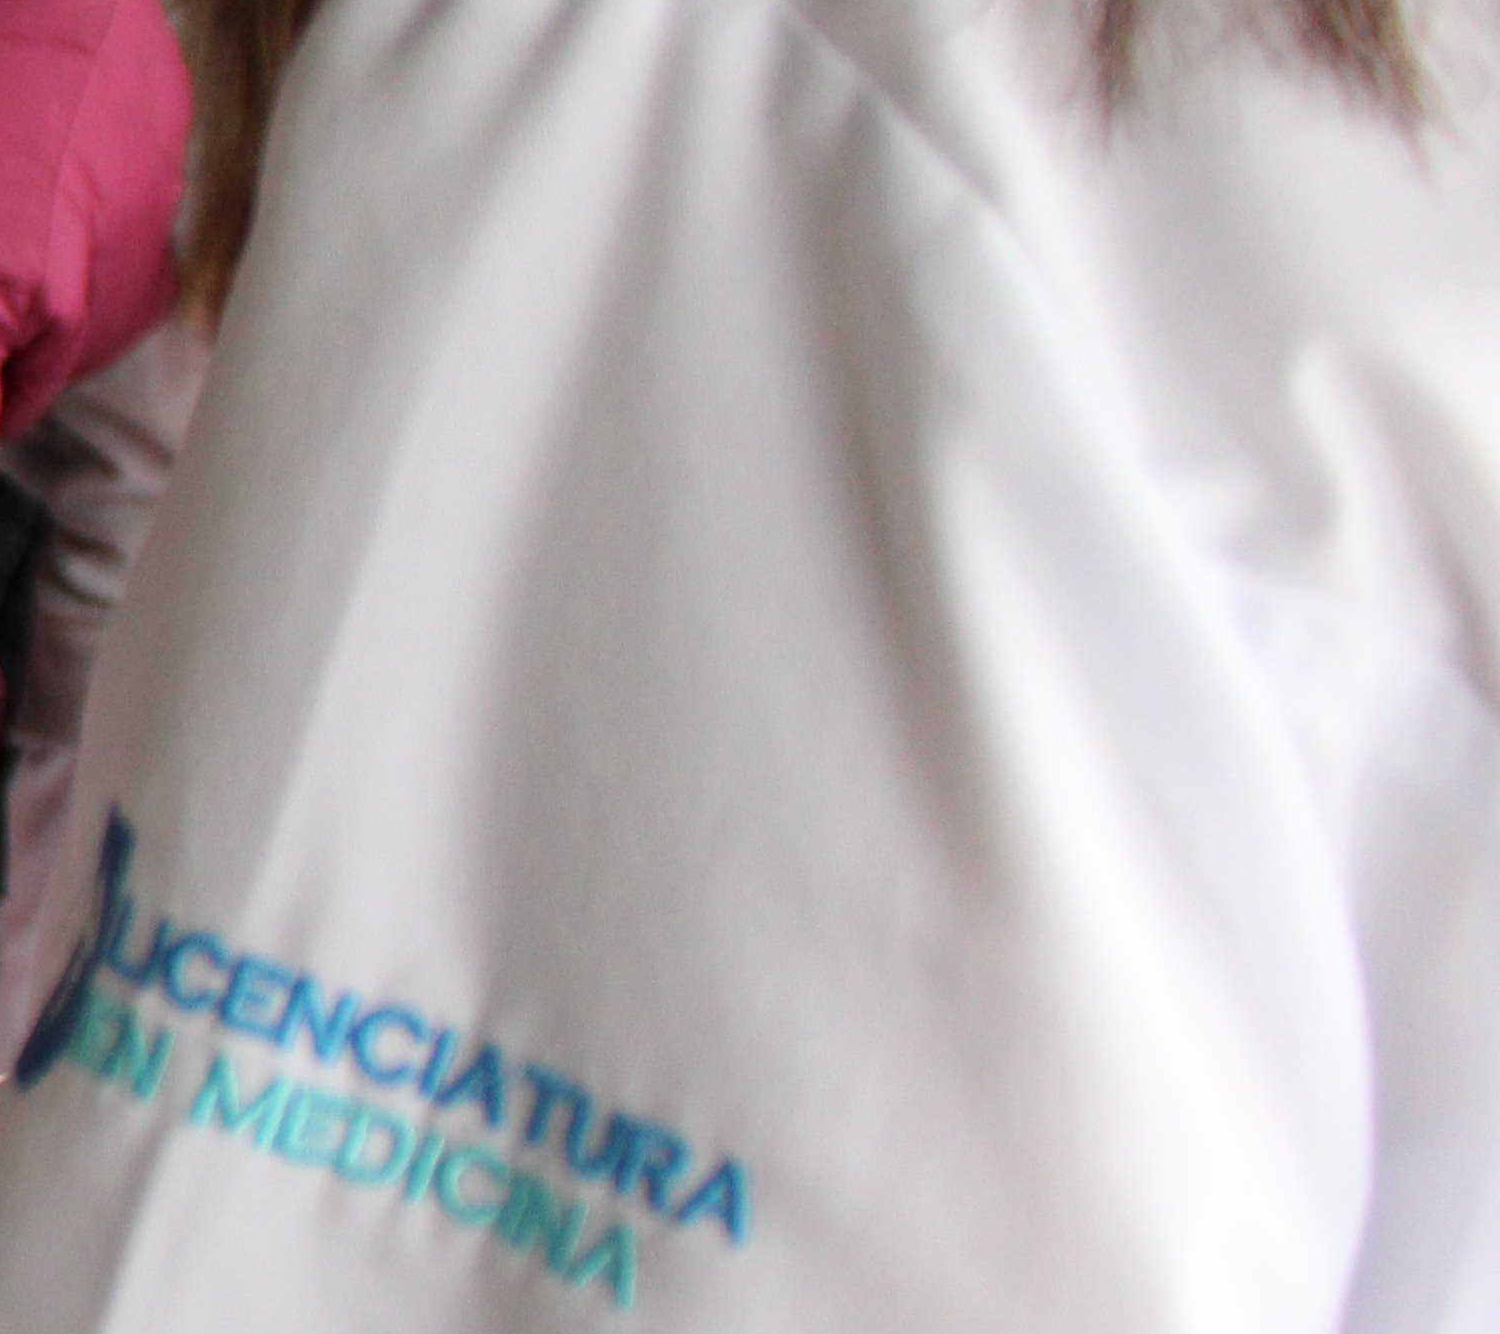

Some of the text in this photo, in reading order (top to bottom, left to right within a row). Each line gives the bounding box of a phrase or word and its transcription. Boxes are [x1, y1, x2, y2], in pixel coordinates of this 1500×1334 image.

[66, 985, 639, 1311] EN MEDICINA
[100, 887, 750, 1247] LICENCIATURA
